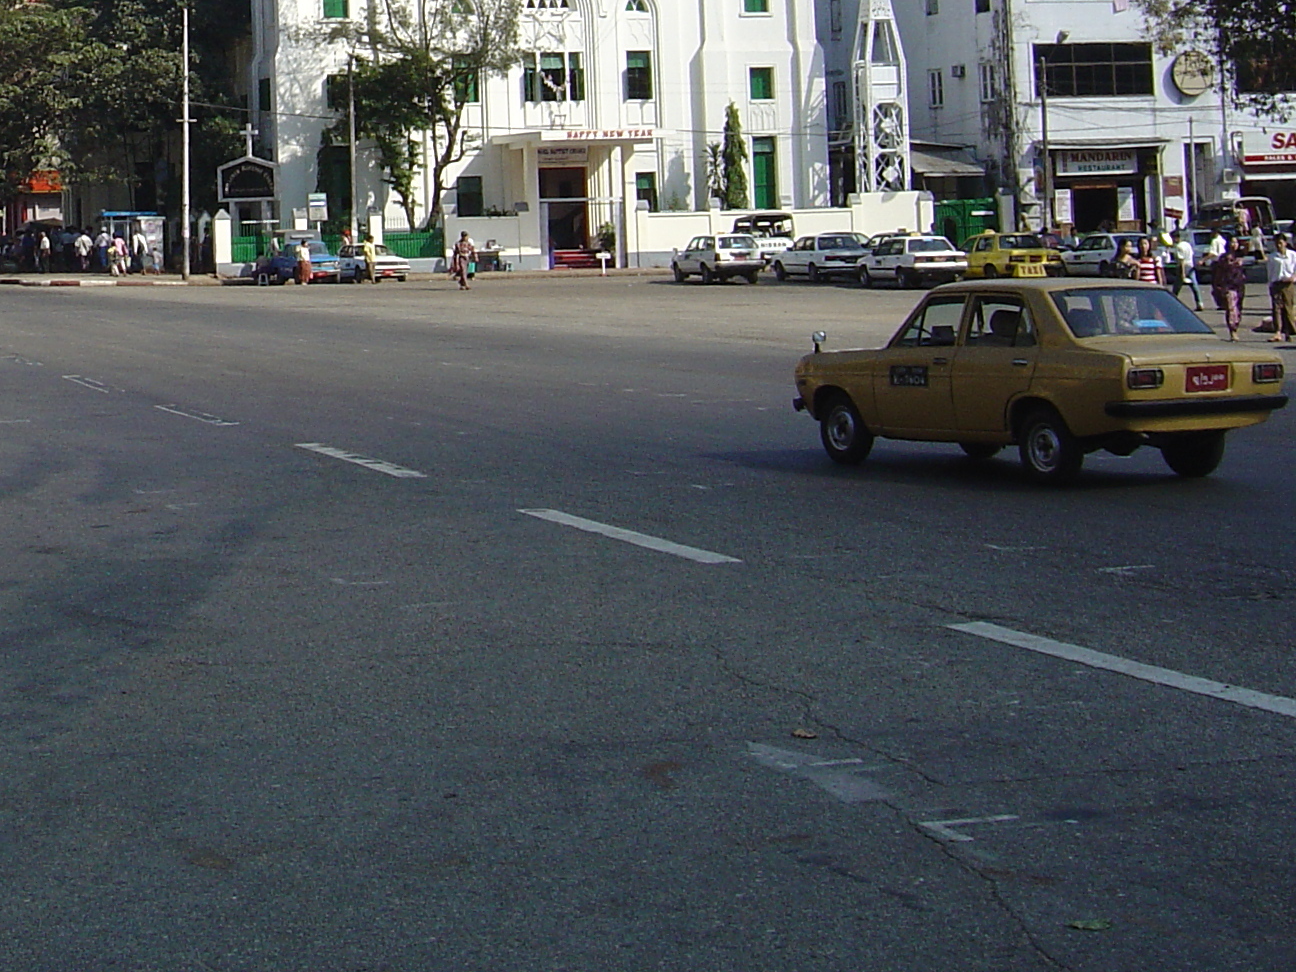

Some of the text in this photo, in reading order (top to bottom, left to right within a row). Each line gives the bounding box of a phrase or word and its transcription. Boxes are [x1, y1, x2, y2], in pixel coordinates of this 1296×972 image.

[567, 129, 653, 139] HAPPY NEW YEAR
[1070, 150, 1132, 162] MANDARIN
[1078, 163, 1126, 172] RESTAURANT
[1019, 265, 1043, 275] TAXI
